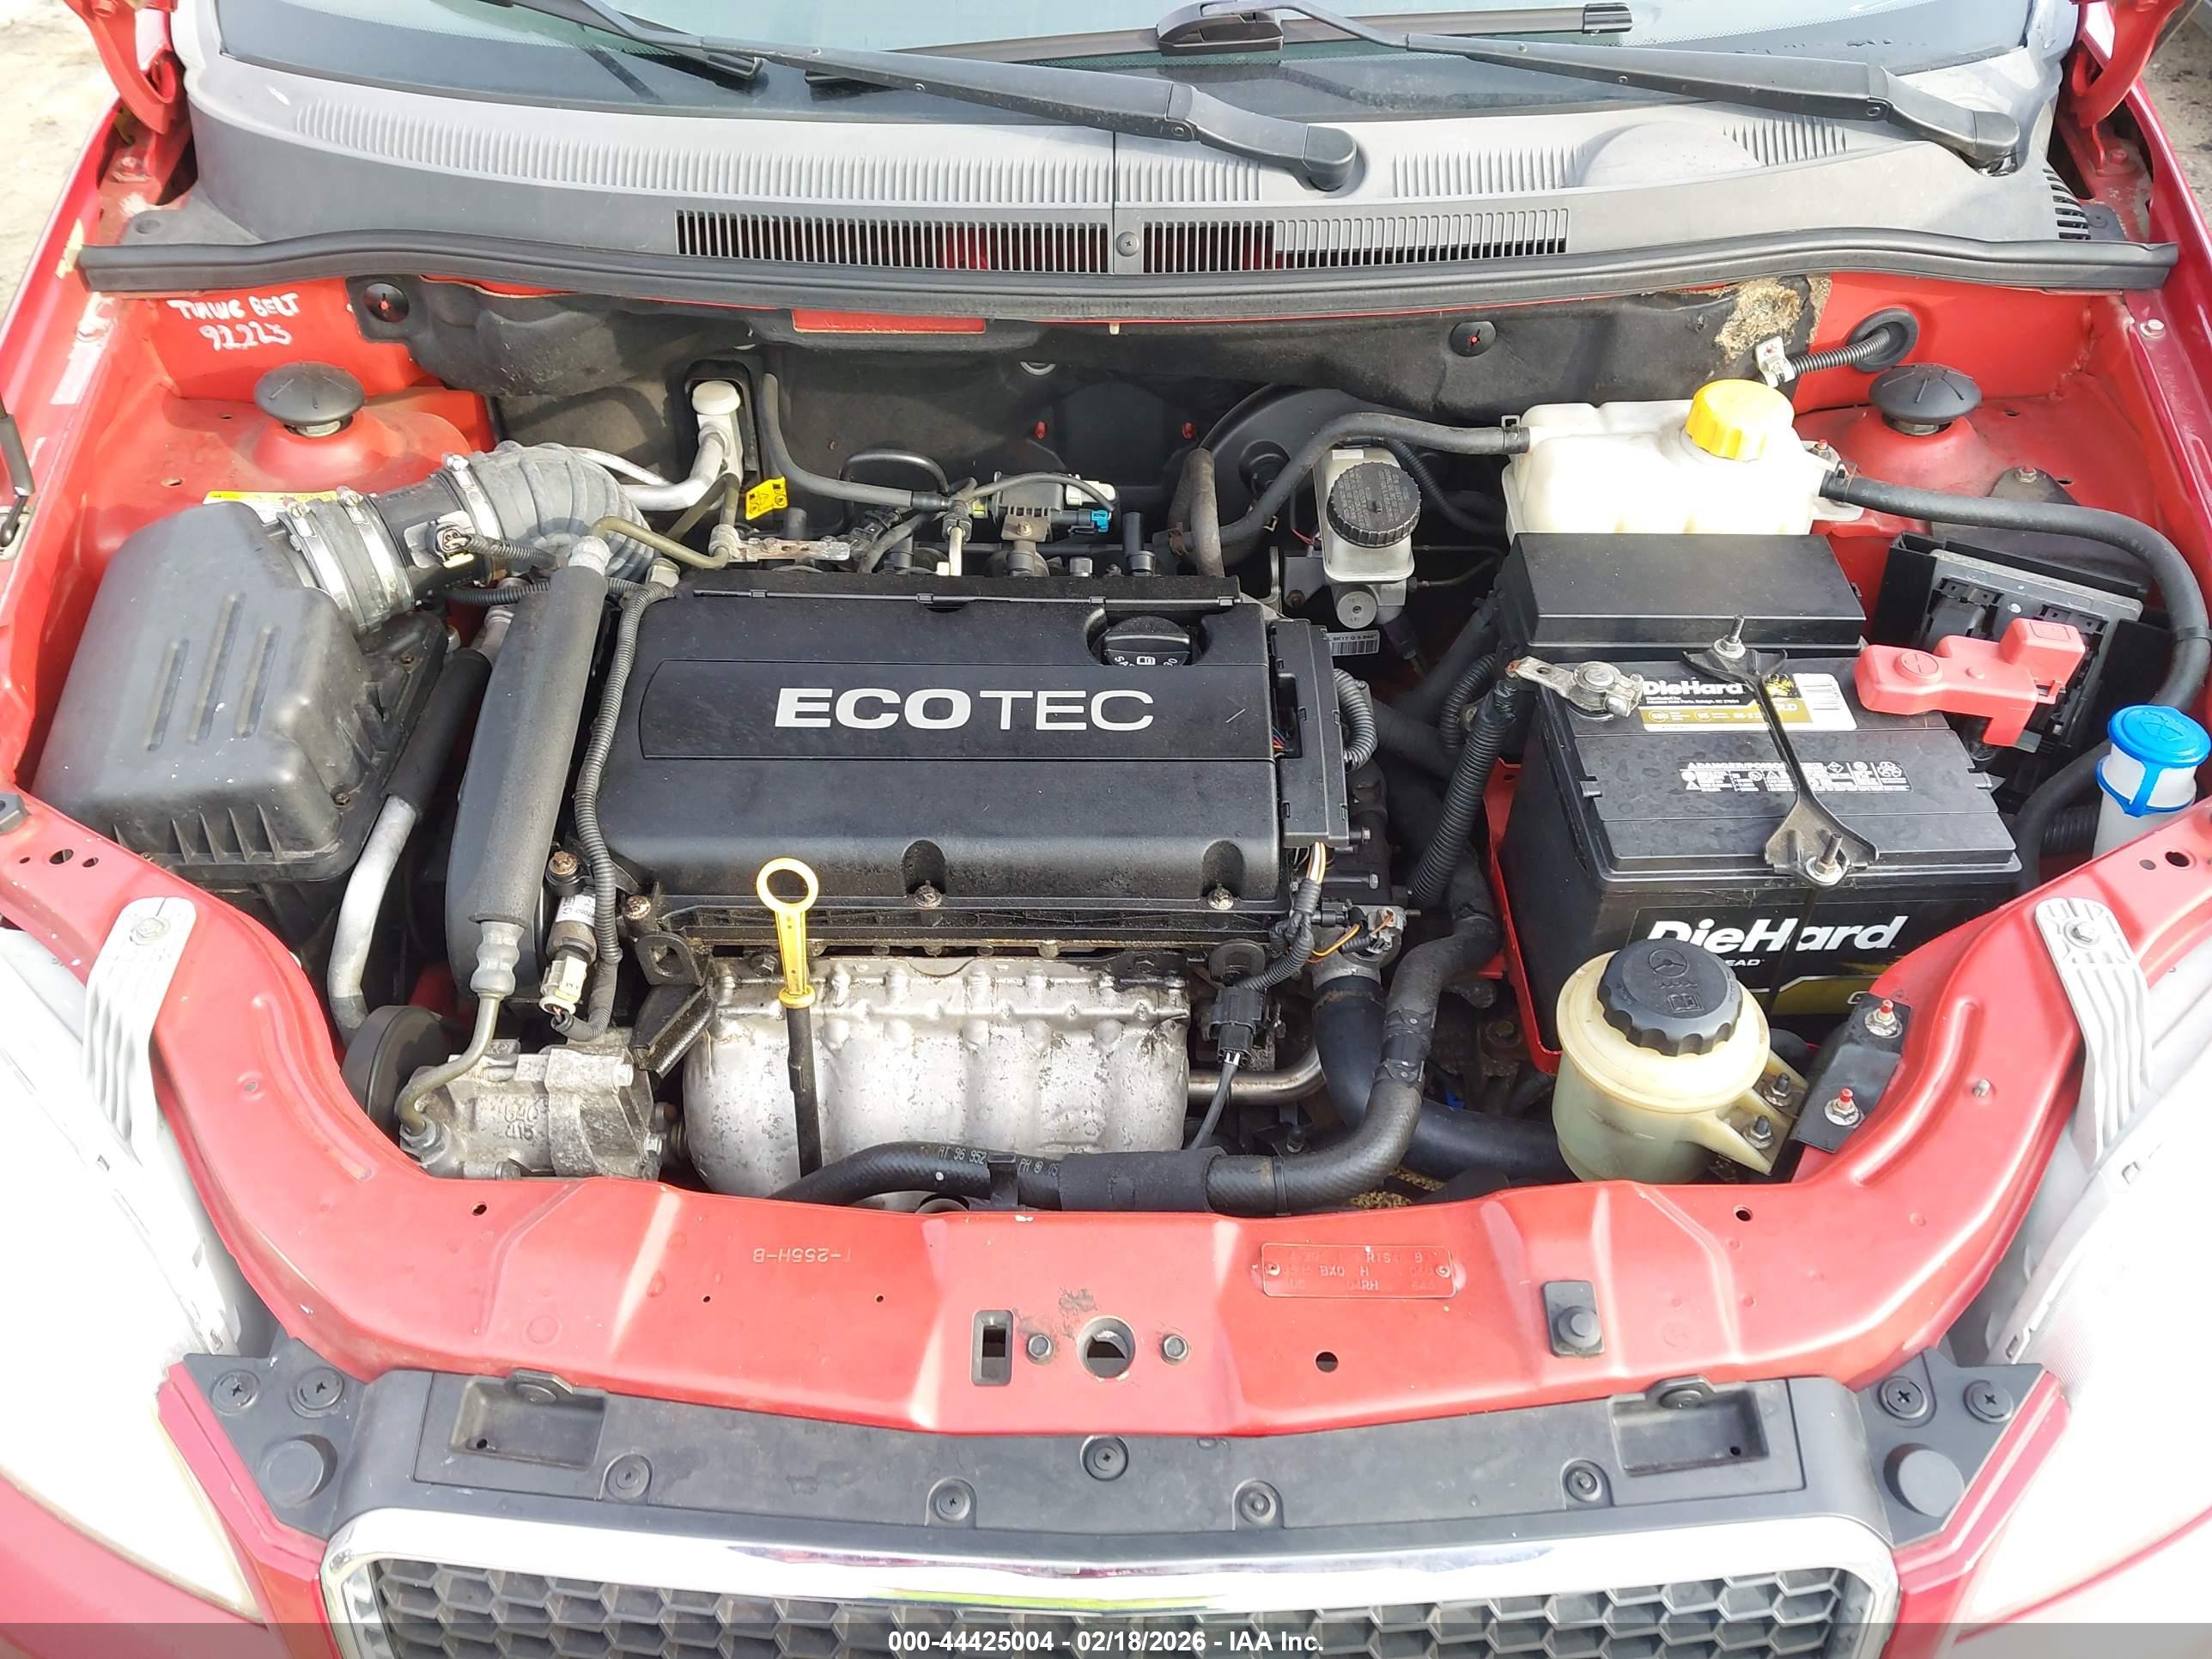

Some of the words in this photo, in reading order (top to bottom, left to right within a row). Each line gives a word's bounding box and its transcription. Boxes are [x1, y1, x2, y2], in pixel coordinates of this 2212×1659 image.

[248, 293, 301, 318] BELT
[1642, 678, 1745, 696] DieHard
[775, 688, 1154, 731] ECOTEC
[1647, 915, 1909, 954] DieHard
